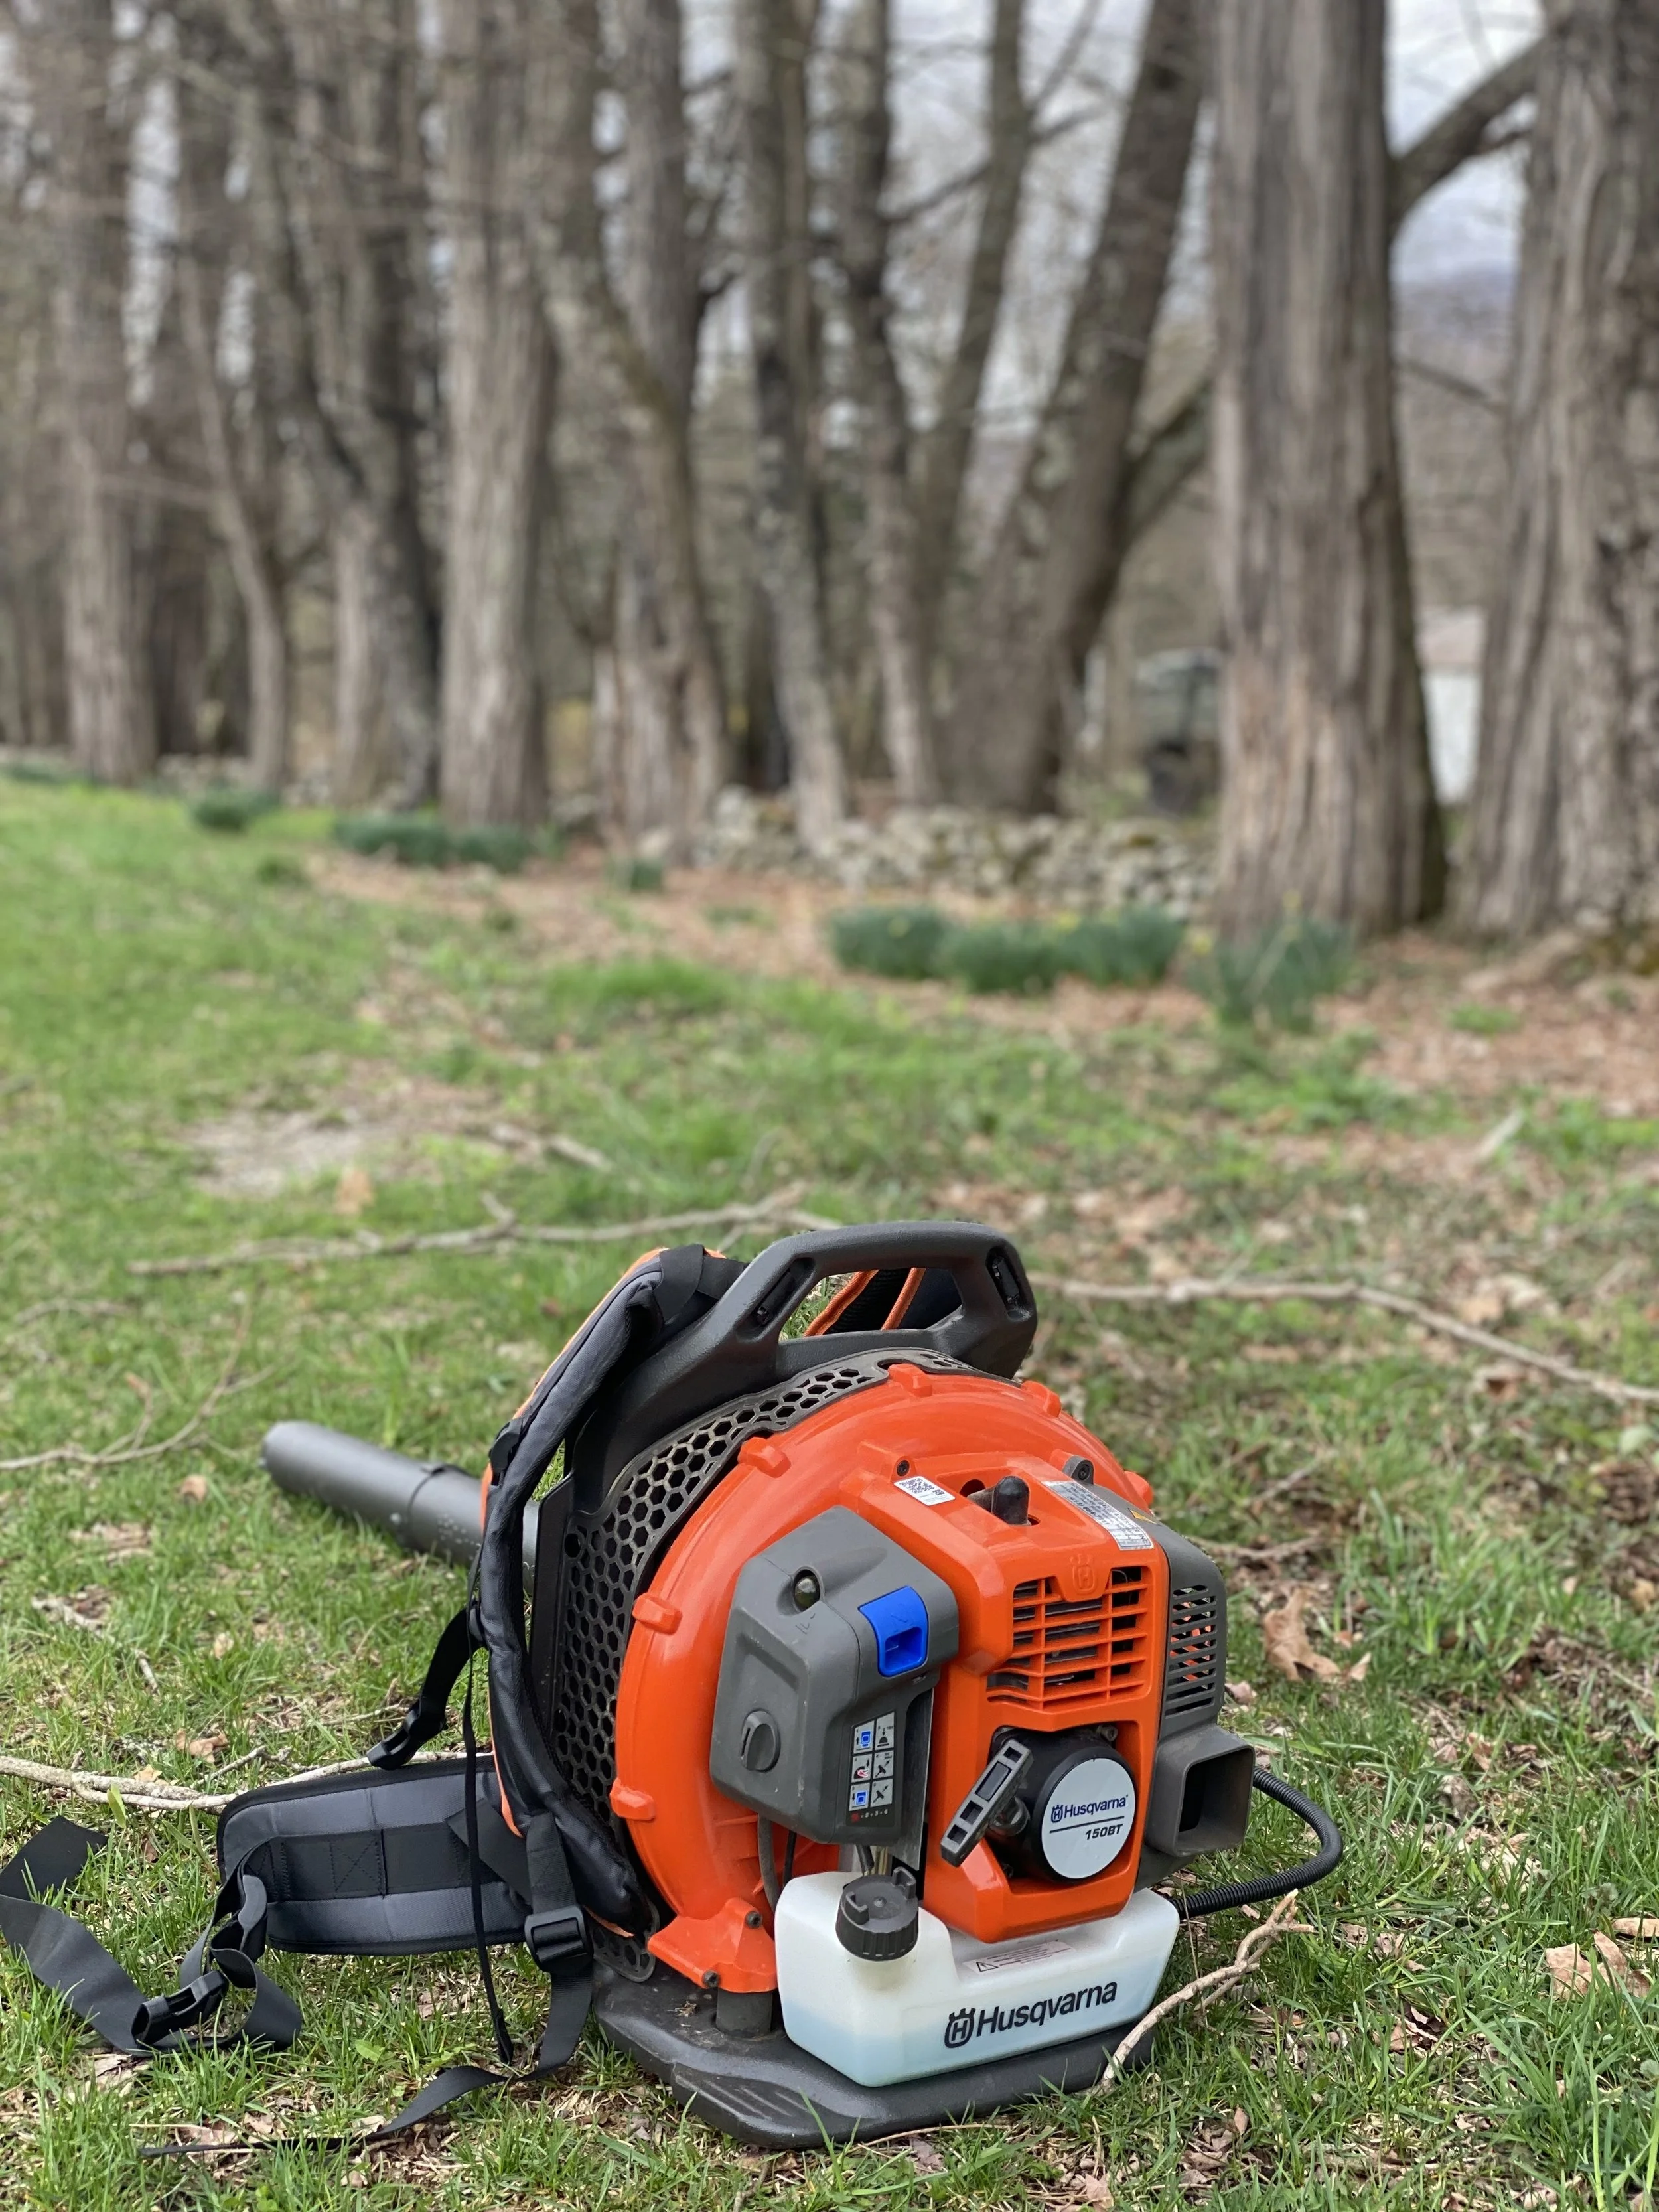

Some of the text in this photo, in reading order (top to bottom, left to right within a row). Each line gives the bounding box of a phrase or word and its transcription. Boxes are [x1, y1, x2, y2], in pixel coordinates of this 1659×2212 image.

[1064, 1797, 1127, 1819] Husqvarna
[1085, 1823, 1123, 1840] 150BT
[976, 1981, 1118, 2037] Husqvarna
